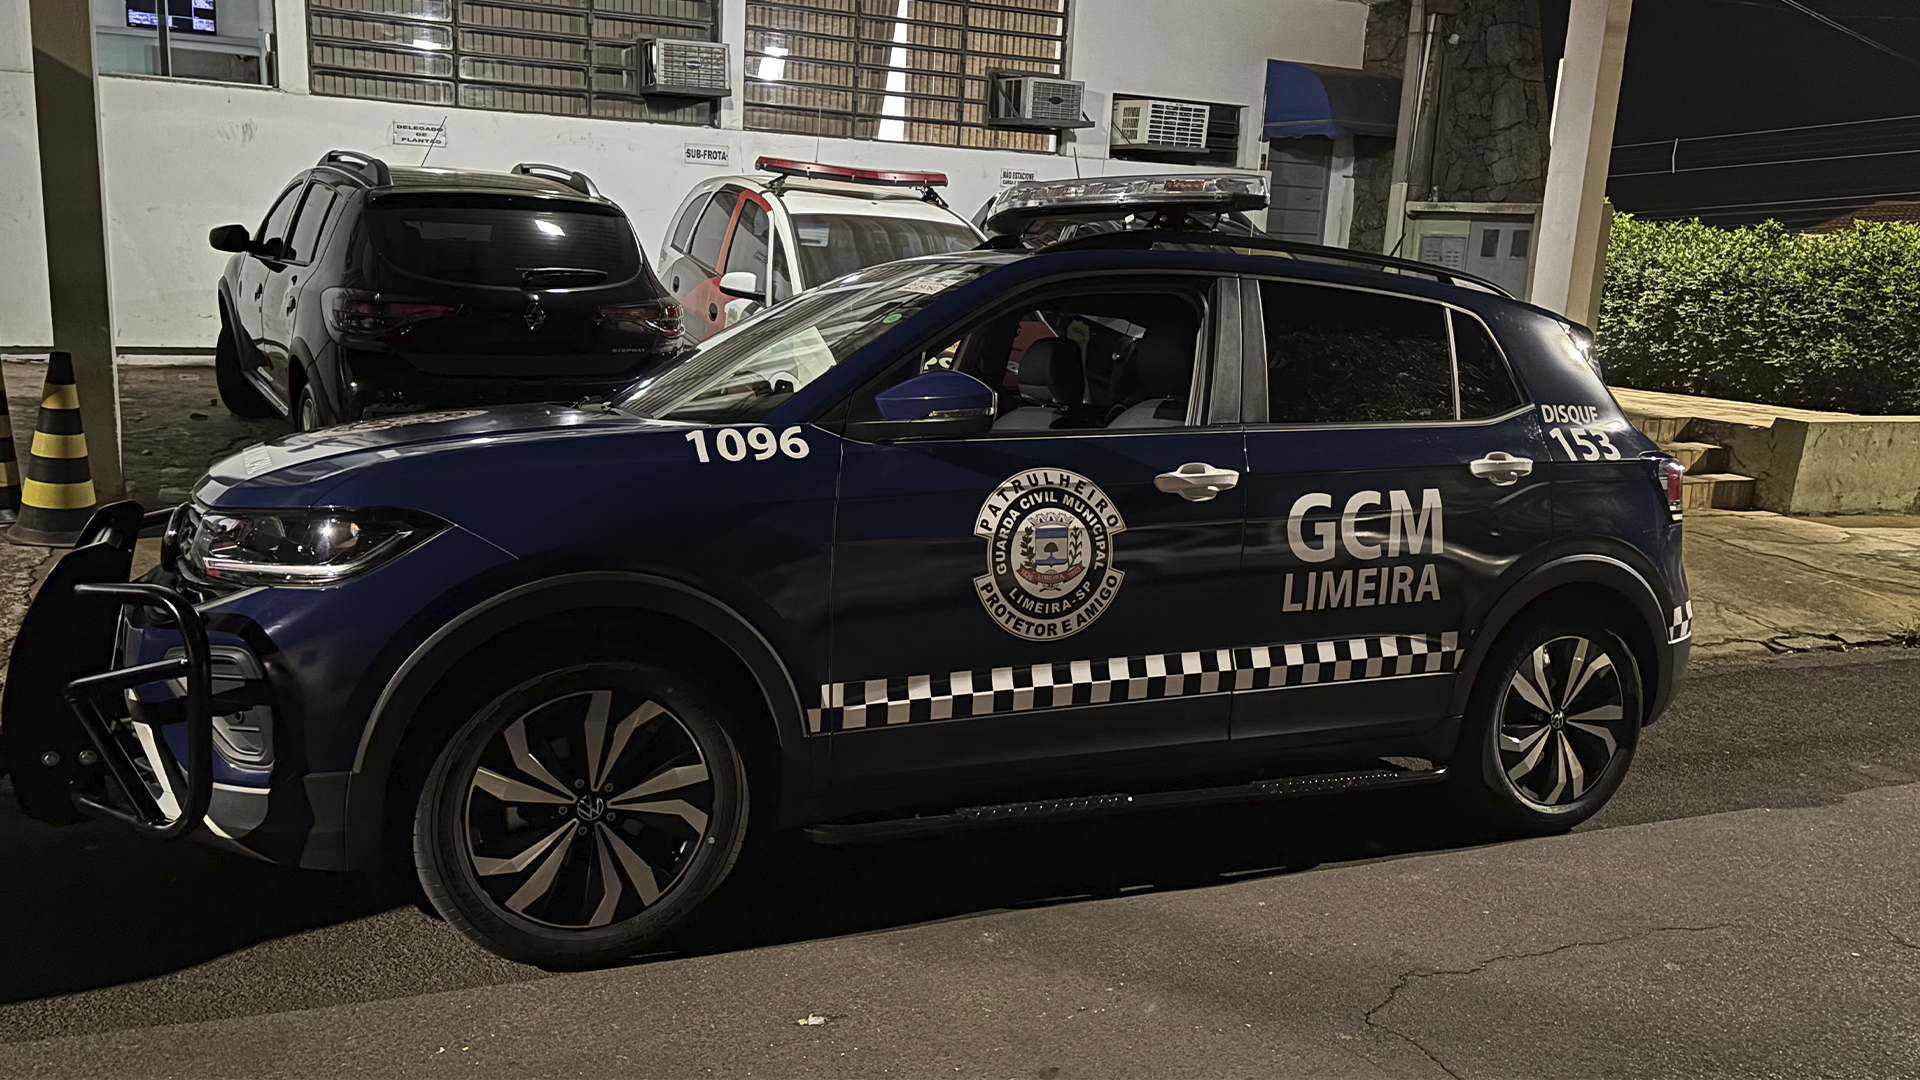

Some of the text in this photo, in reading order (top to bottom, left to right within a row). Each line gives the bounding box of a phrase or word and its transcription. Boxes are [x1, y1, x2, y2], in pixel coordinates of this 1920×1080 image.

[396, 124, 444, 132] DELEGADO
[685, 148, 728, 161] SUB-FROTA
[1540, 404, 1599, 426] DISQUE
[685, 425, 810, 463] 1096
[1548, 428, 1621, 462] 153
[979, 471, 1119, 532] PATRULHEIRO
[995, 491, 1106, 575] GUARDA CIVIL MUNICIPAL
[1287, 488, 1444, 563] GCM
[980, 575, 1118, 637] PROTETOR E AMIGO
[1282, 563, 1441, 612] LIMEIRA
